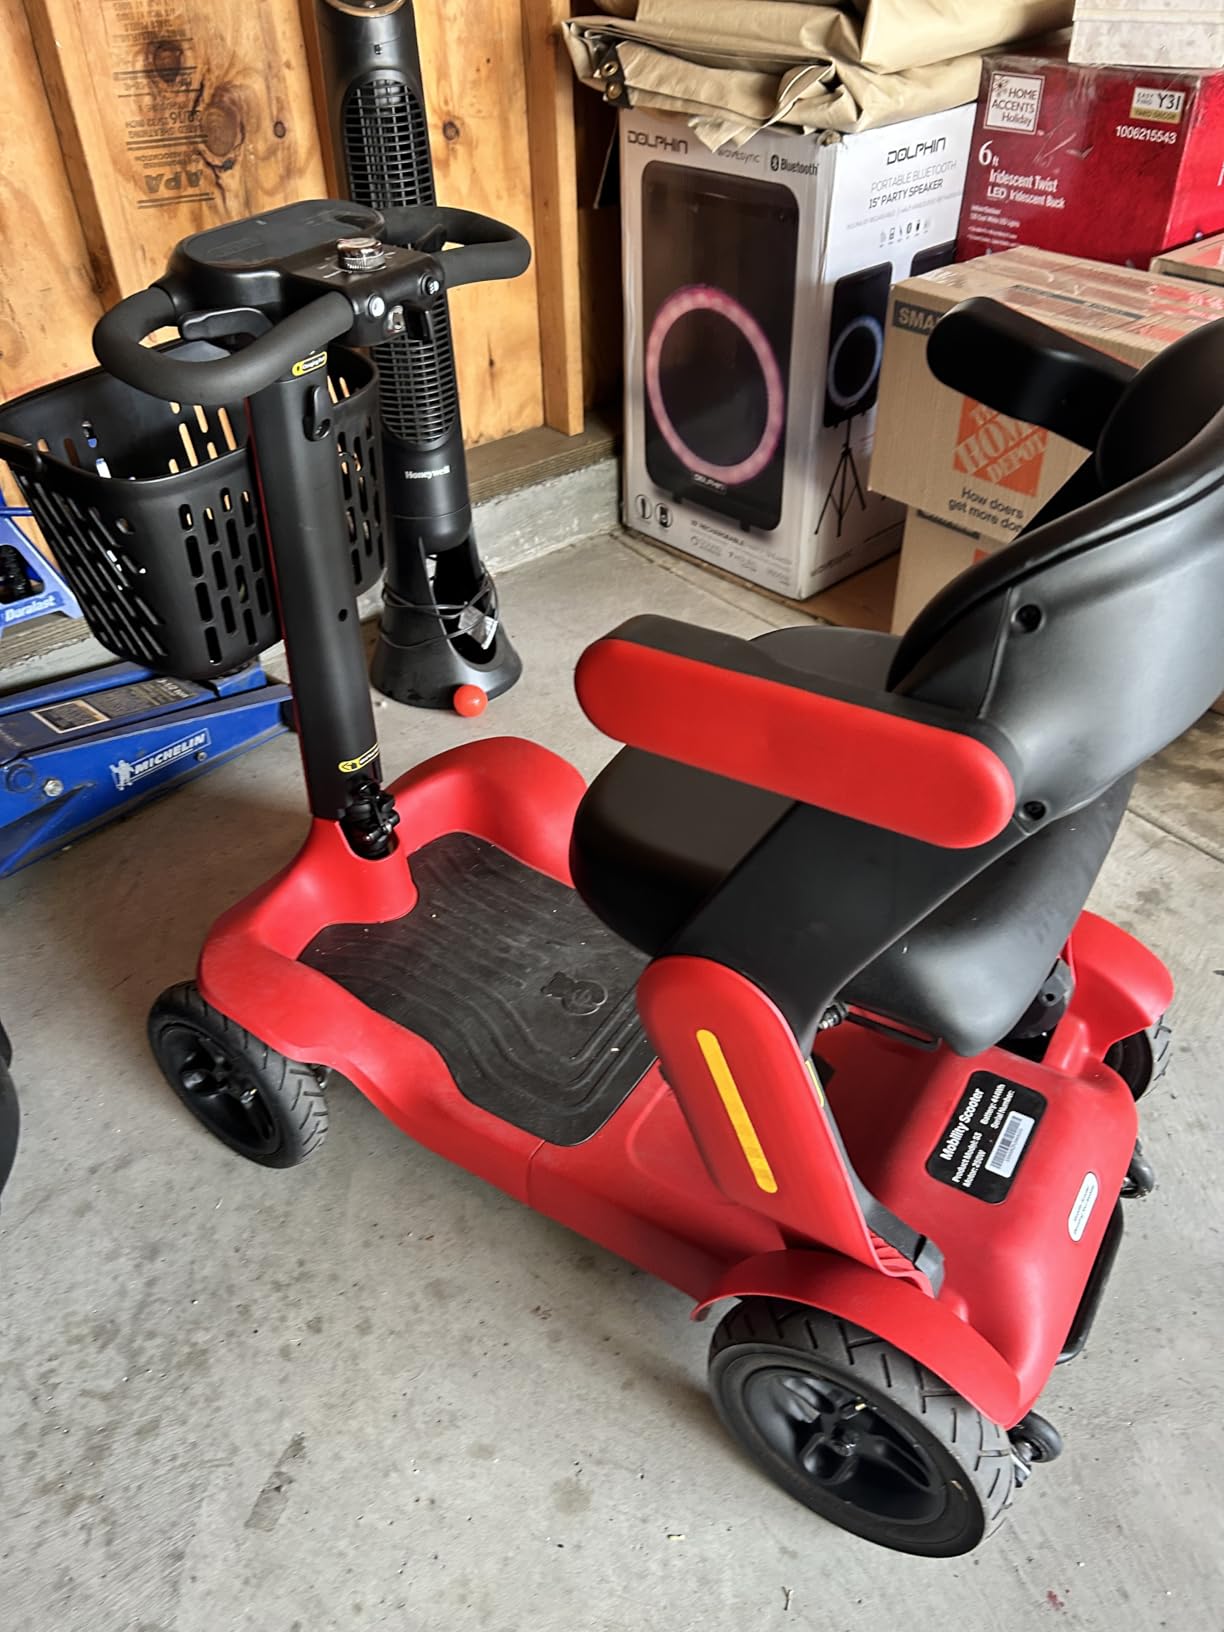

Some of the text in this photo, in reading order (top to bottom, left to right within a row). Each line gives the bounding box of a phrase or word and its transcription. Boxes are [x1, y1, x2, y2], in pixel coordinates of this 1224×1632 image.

[992, 99, 1035, 113] ACCENTS
[1008, 87, 1038, 100] HOME
[1002, 111, 1033, 127] Holiday
[627, 130, 689, 154] DOLPHIN
[780, 158, 818, 176] Bluetooth
[886, 137, 947, 165] DOLPHIN
[978, 140, 993, 166] 6
[144, 171, 204, 193] APA
[881, 189, 907, 204] PARTY
[909, 178, 944, 197] SPEAKER
[988, 168, 1058, 193] Iridescent Twist
[987, 186, 1007, 199] LED
[1009, 190, 1046, 205] Iridescent
[404, 465, 451, 480] Honeywell
[948, 499, 967, 513] get
[968, 507, 998, 524] more
[961, 487, 1024, 519] How doers
[132, 733, 206, 775] MICHELIN
[940, 1087, 984, 1161] Mobility Scooter
